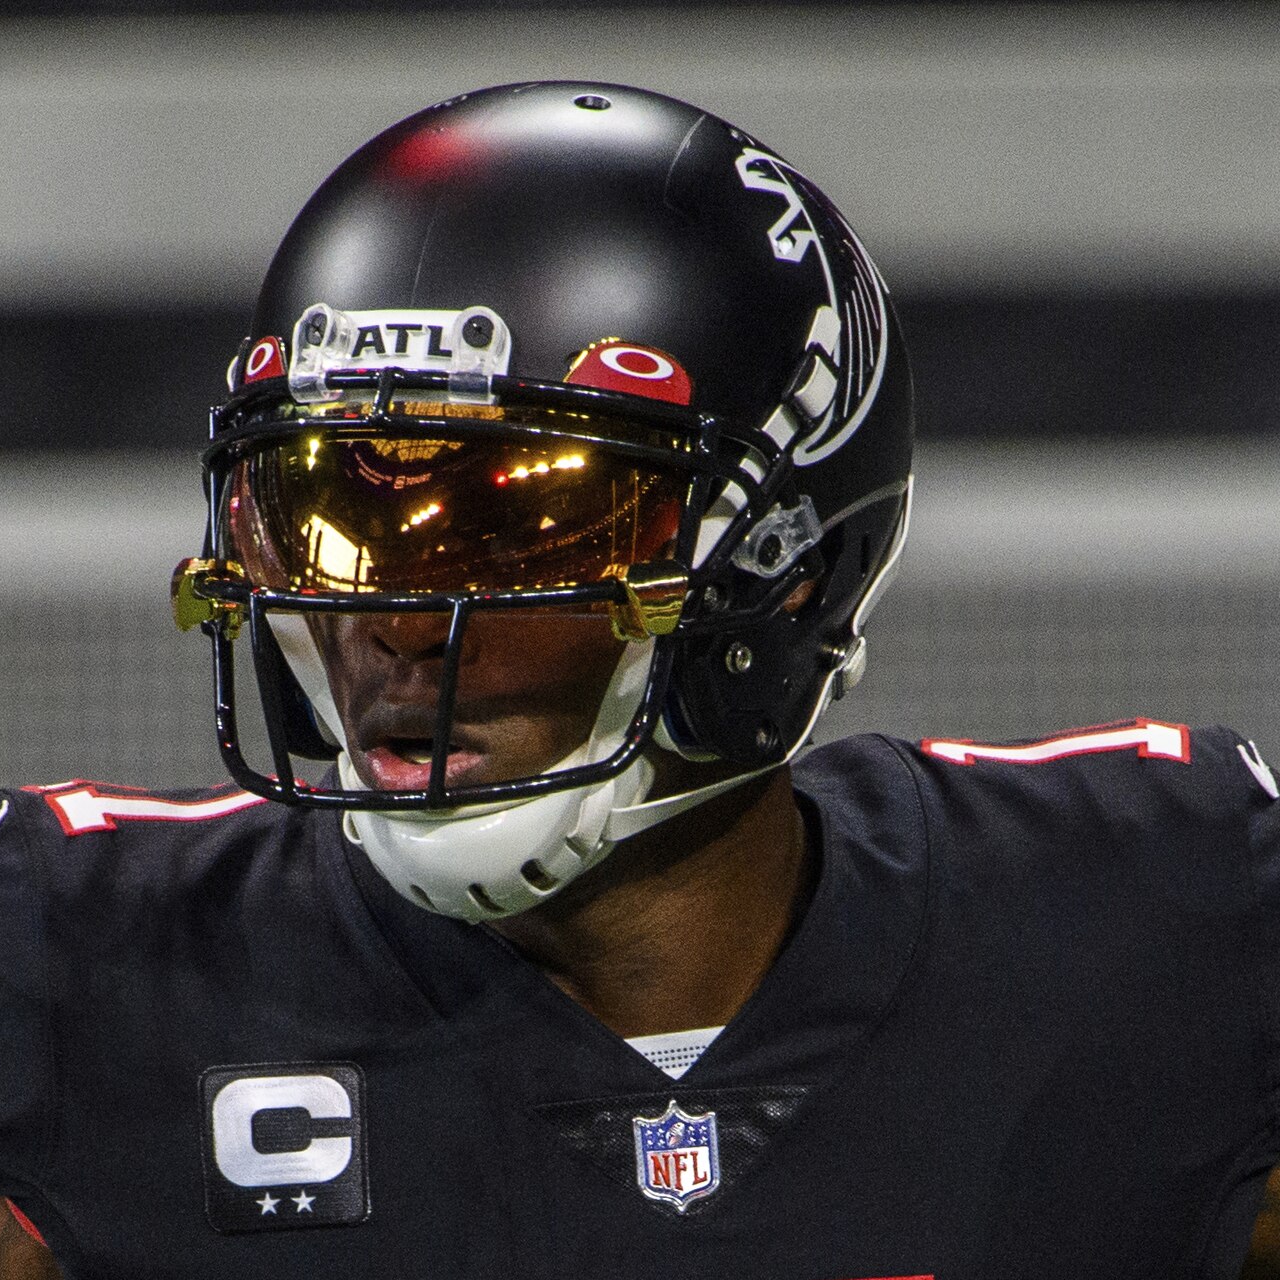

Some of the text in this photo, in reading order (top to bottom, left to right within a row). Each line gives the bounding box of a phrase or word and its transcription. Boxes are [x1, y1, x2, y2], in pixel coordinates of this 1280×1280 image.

[351, 323, 453, 358] ATL
[212, 1075, 353, 1188] C
[650, 1150, 708, 1192] NFL
